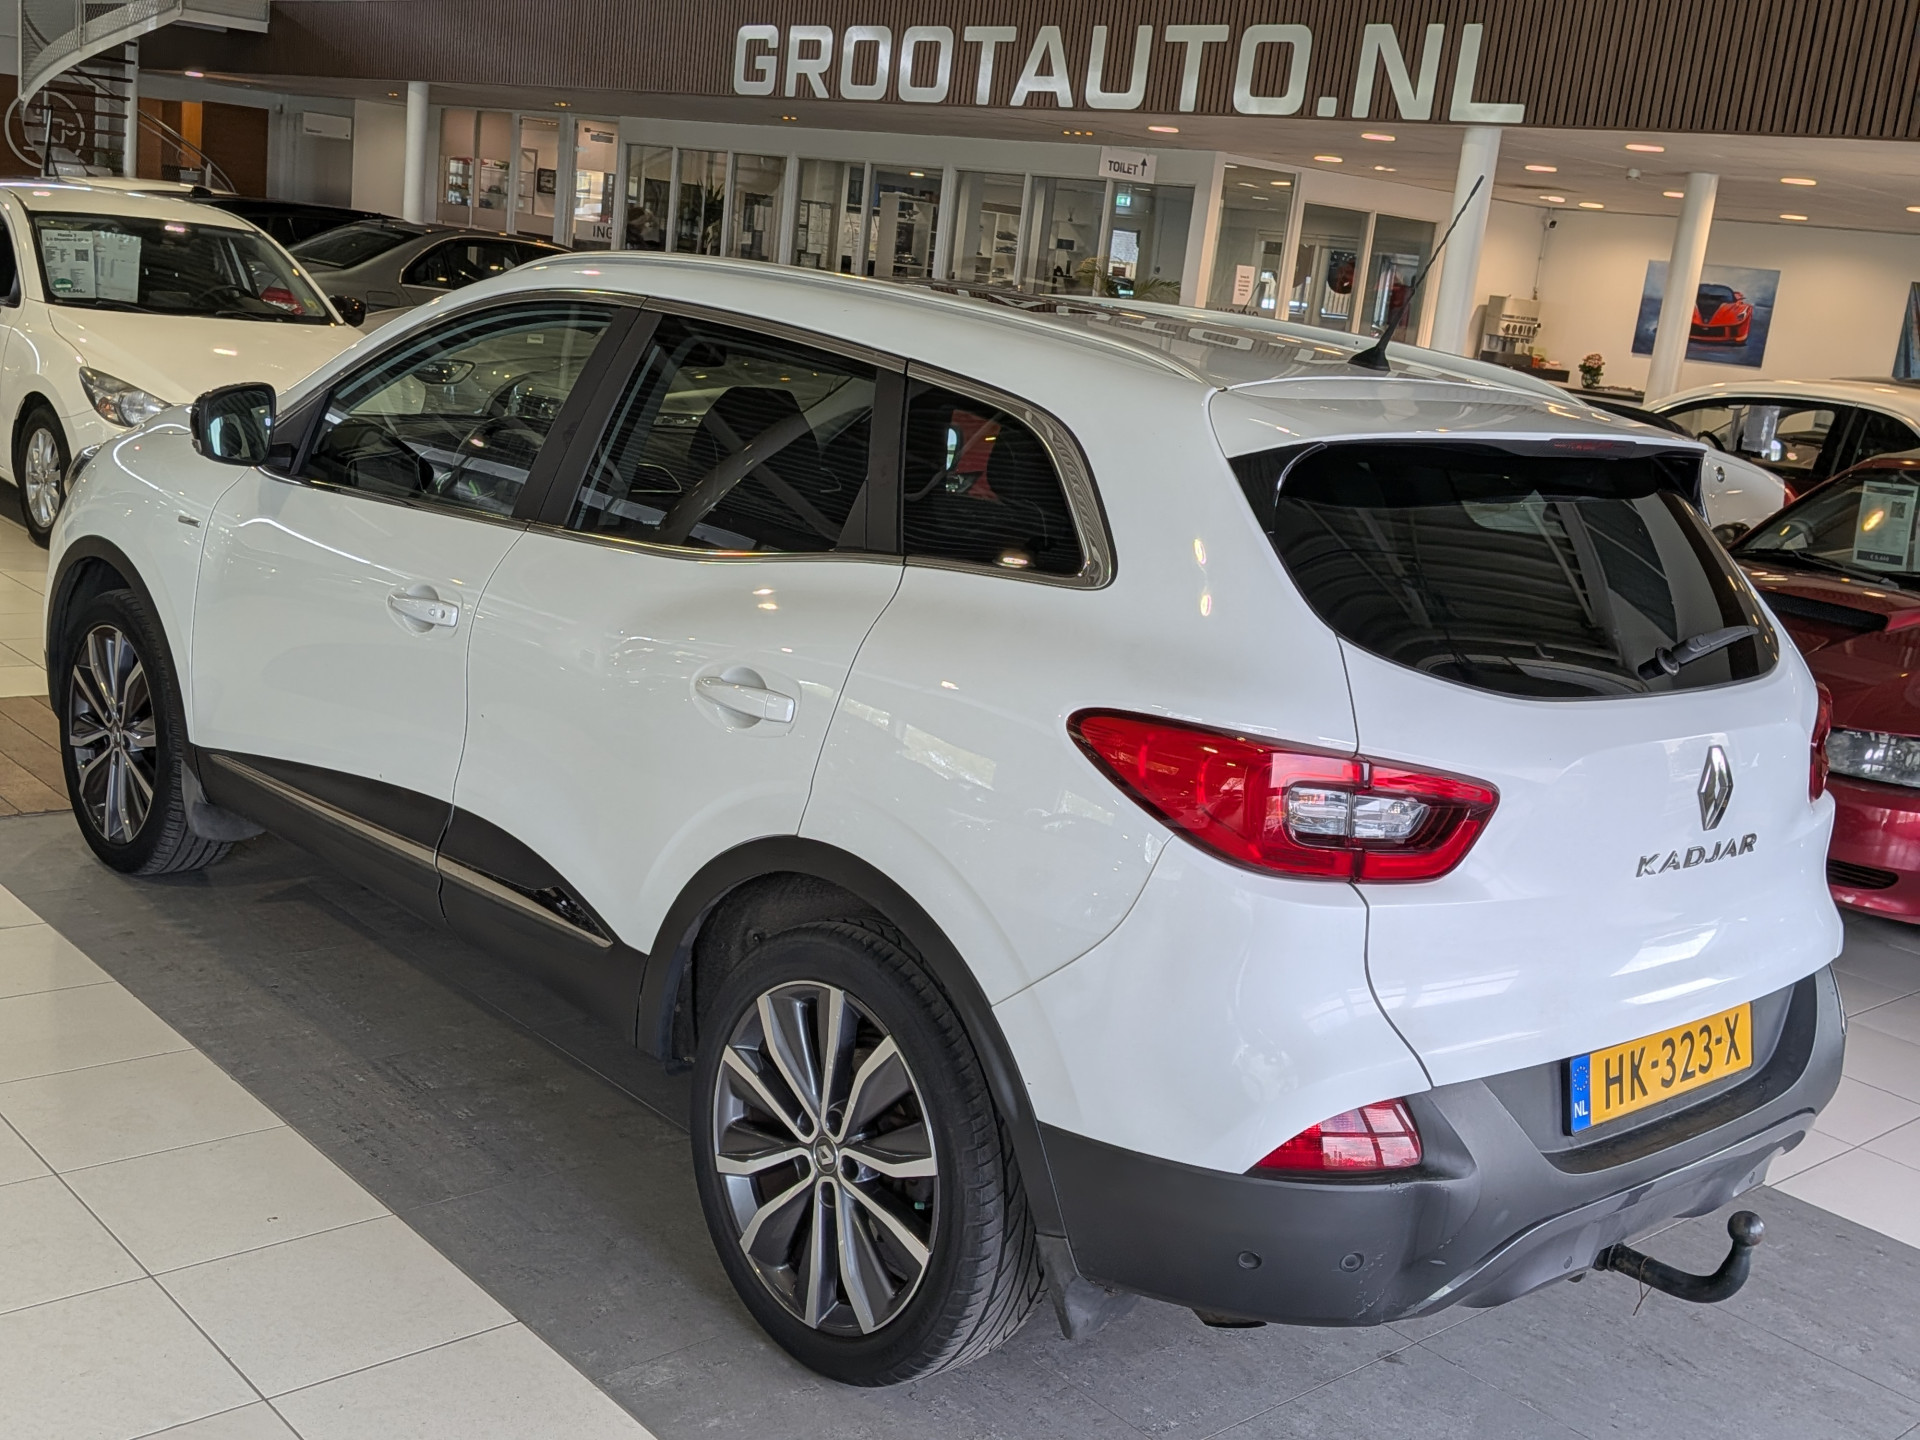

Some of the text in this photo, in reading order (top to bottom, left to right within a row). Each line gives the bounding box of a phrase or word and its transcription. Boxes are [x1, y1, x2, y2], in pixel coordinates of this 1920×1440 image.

[733, 24, 1525, 124] GROOTAUTO.NL
[1108, 159, 1139, 176] TOILET
[1635, 832, 1758, 878] KADJAR
[1604, 1012, 1741, 1110] HK-323-X
[1573, 1102, 1589, 1119] NL
